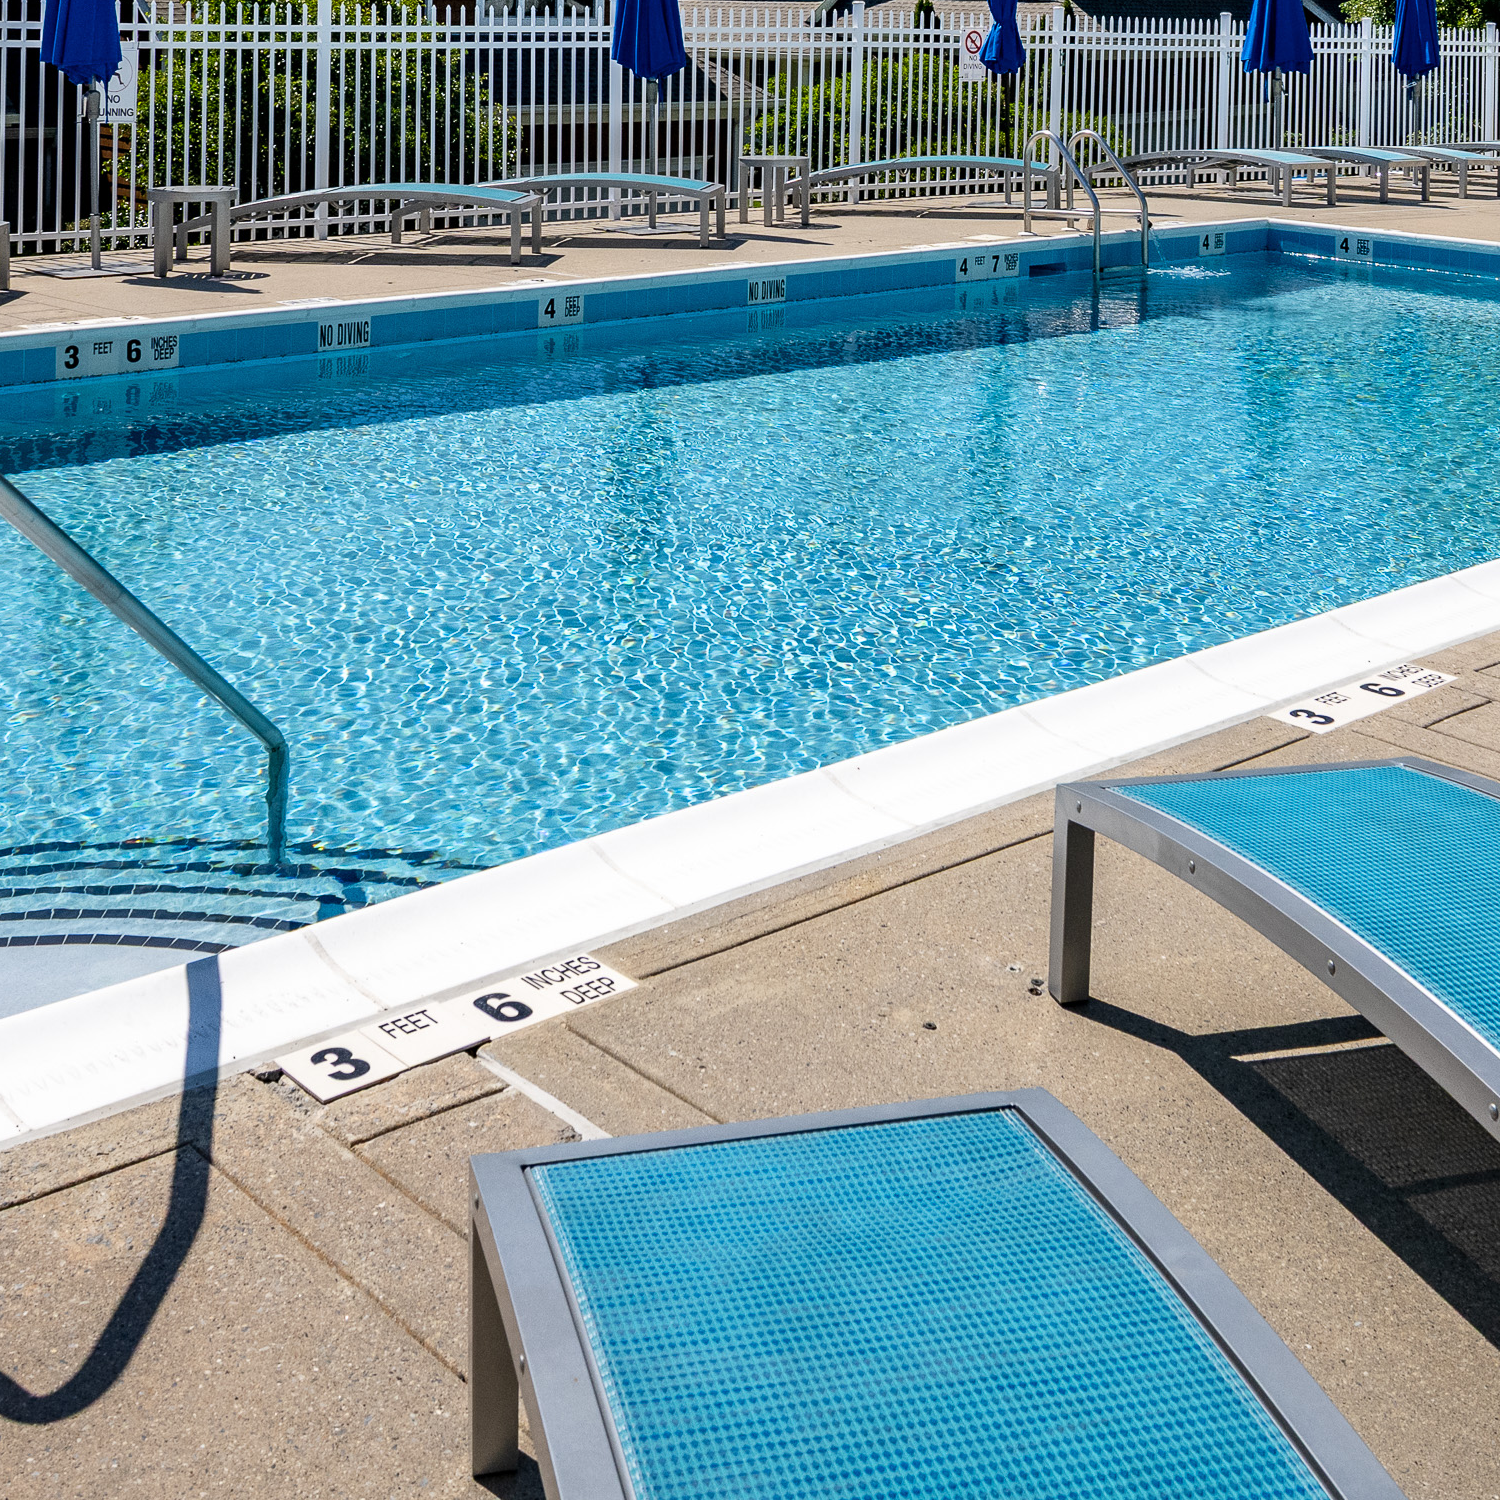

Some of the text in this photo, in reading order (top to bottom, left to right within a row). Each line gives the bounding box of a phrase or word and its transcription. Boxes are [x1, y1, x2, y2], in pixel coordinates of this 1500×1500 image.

[99, 108, 134, 117] UNNING
[1203, 234, 1209, 250] 4
[1340, 237, 1349, 253] 4
[960, 258, 968, 275] 4
[992, 255, 999, 273] 7
[749, 279, 785, 301] NO DIVING
[544, 296, 580, 318] 4 FEET
[565, 306, 580, 317] DEEP
[320, 321, 369, 347] NO DIVING
[64, 335, 177, 369] 3 FEET 6 INCHES
[154, 348, 174, 360] DEEP
[1289, 709, 1335, 725] 3
[1359, 682, 1405, 697] 6
[559, 976, 618, 1005] DEEP
[310, 955, 601, 1081] 3 FEET 6 INCHES
